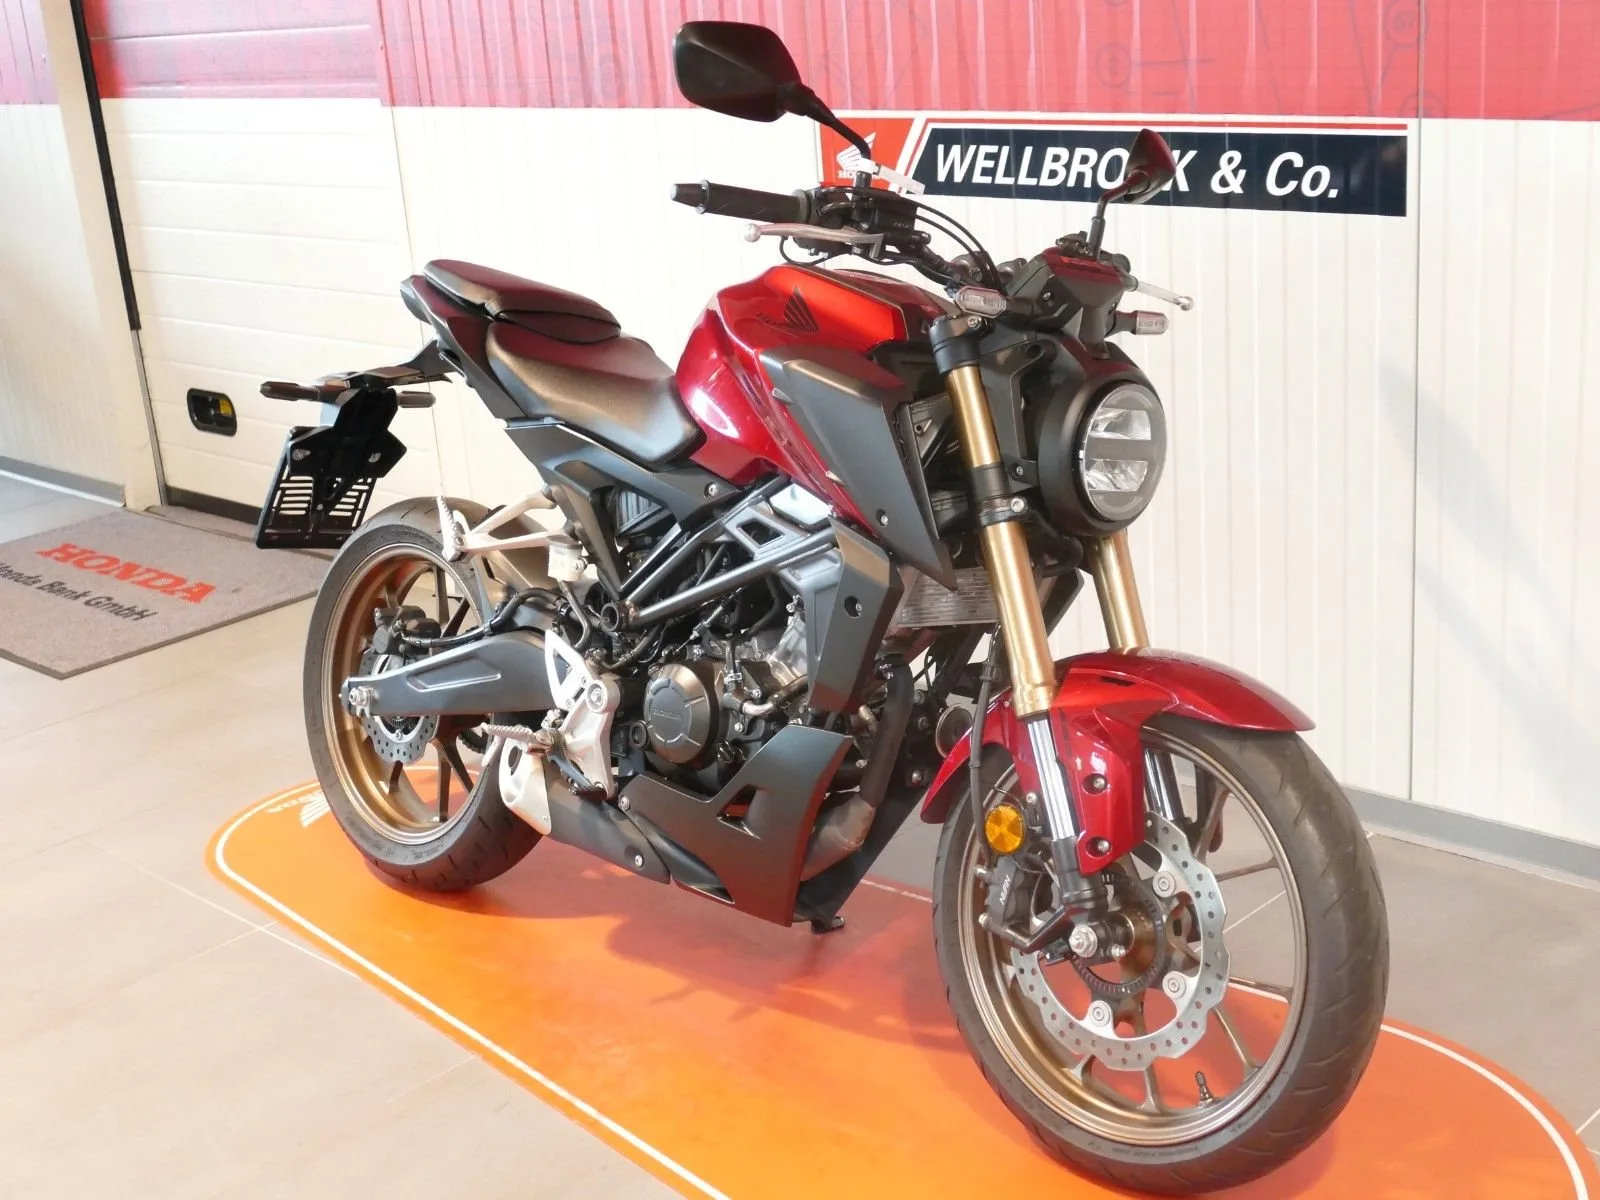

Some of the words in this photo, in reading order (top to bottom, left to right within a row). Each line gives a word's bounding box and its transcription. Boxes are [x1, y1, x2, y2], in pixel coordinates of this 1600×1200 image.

[937, 143, 1196, 192] WELLBROK
[1210, 150, 1246, 194] &
[1266, 151, 1338, 198] Co.
[36, 543, 216, 604] HONDA
[36, 580, 91, 600] Bank
[83, 596, 158, 621] GmbH
